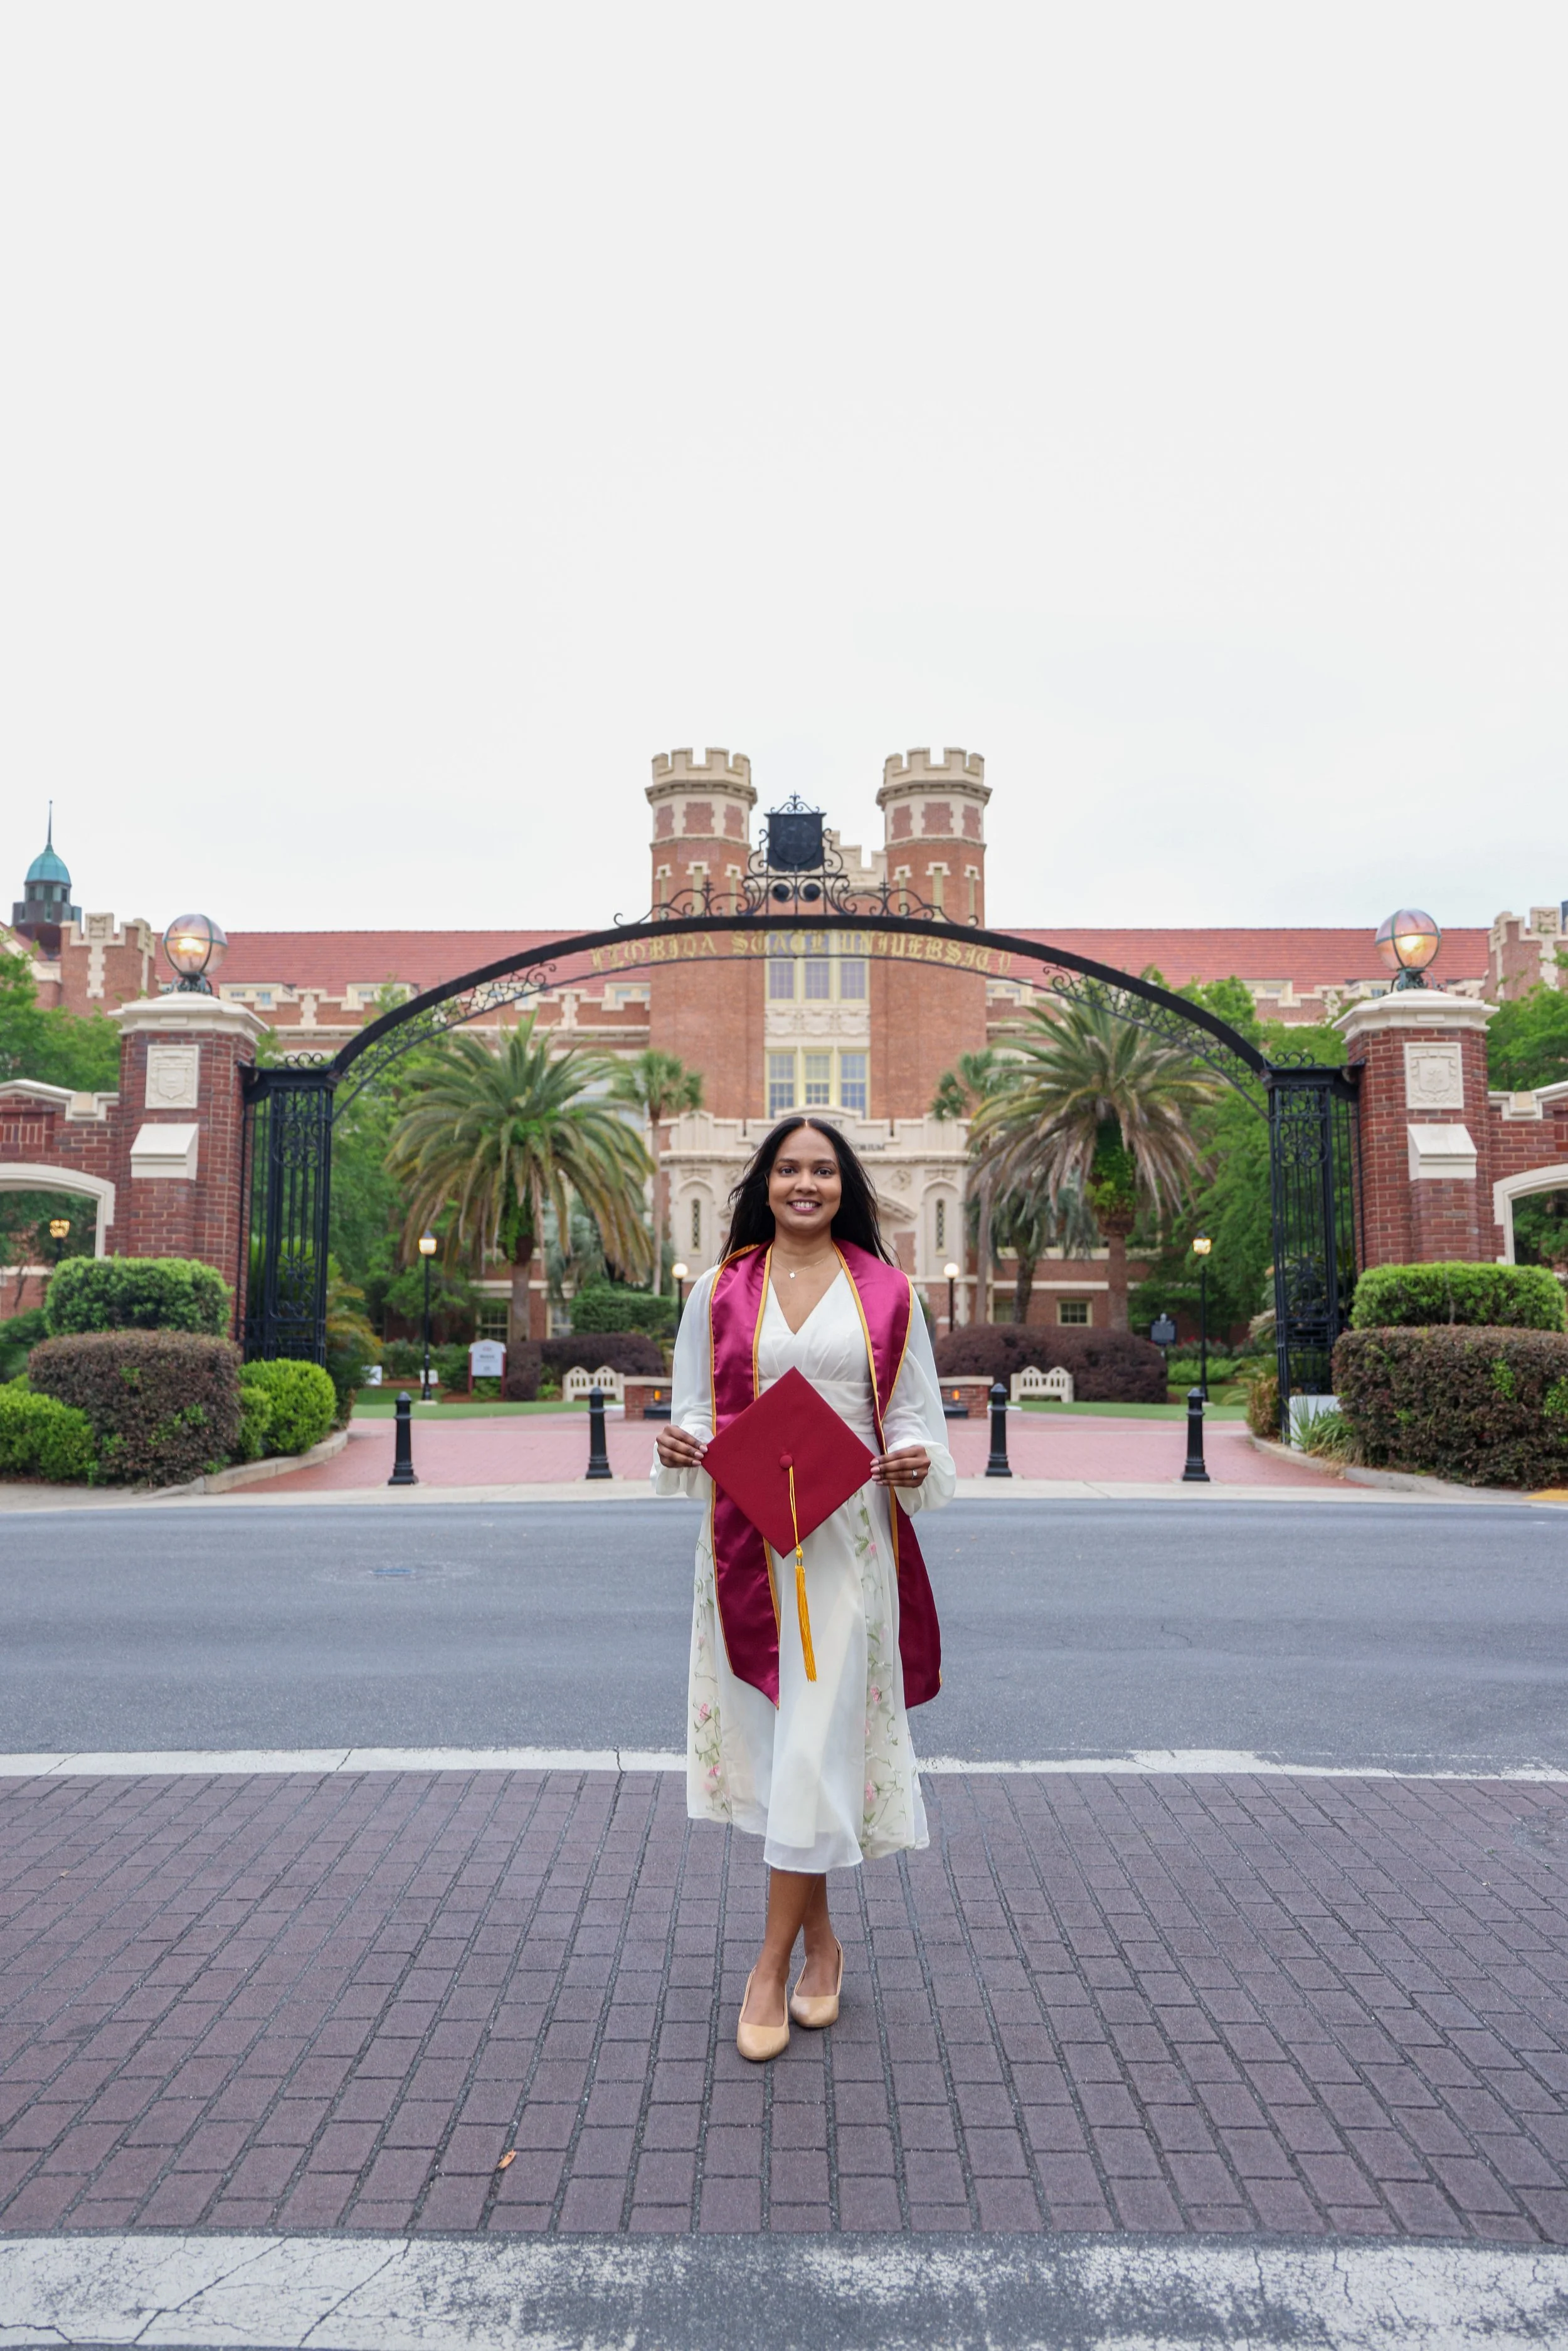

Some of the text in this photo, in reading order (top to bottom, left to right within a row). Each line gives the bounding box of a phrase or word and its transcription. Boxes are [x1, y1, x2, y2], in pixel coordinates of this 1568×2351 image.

[591, 930, 1014, 975] FLORIDA STATE UNIVERSITY
